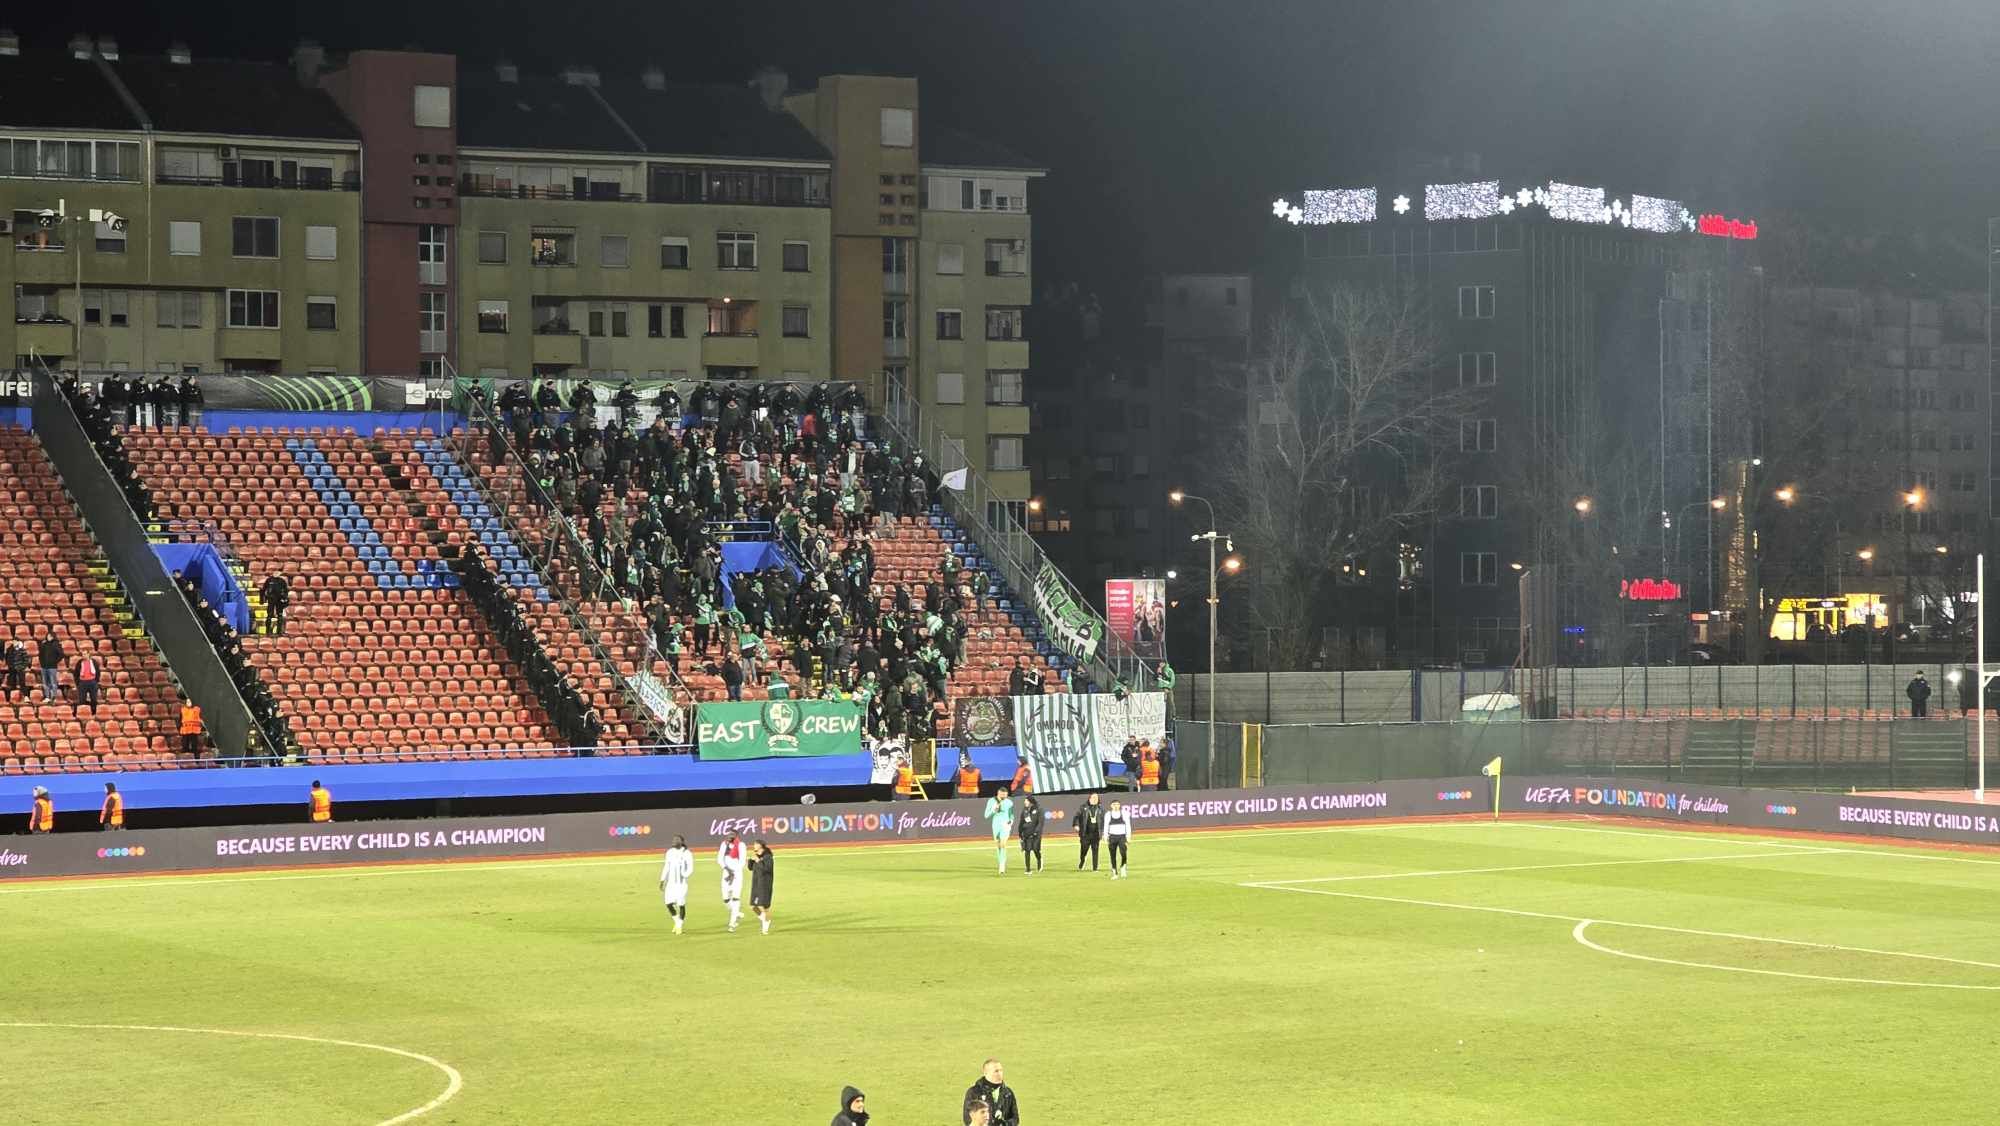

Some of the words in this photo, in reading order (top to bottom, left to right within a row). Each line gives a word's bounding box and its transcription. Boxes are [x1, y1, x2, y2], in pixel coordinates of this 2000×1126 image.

[699, 720, 760, 743] EAST
[802, 714, 858, 734] CREW
[1121, 802, 1184, 818] BECAUSE
[1188, 801, 1232, 816] EVERY
[1236, 798, 1277, 813] CHILD
[1281, 797, 1294, 811] IS
[1297, 796, 1308, 810] A
[1310, 793, 1387, 809] CHAMPION
[1525, 787, 1572, 803] UEFA
[1574, 787, 1676, 810] FOUNDATION
[1678, 795, 1692, 815] for
[1693, 797, 1729, 814] children
[709, 818, 757, 836] UEFA
[761, 813, 893, 834] FOUNDATION
[898, 811, 917, 834] for
[920, 809, 971, 827] children
[1839, 806, 1892, 824] BECAUSE
[1894, 810, 1931, 828] EVERY
[1934, 813, 1972, 831] CHILD
[1974, 816, 1986, 832] IS
[1989, 818, 2000, 833] A
[216, 836, 295, 856] BECAUSE
[299, 834, 353, 852] EVERY
[357, 832, 409, 850] CHILD
[414, 831, 430, 848] IS
[433, 830, 447, 847] A
[450, 827, 545, 846] CHAMPION
